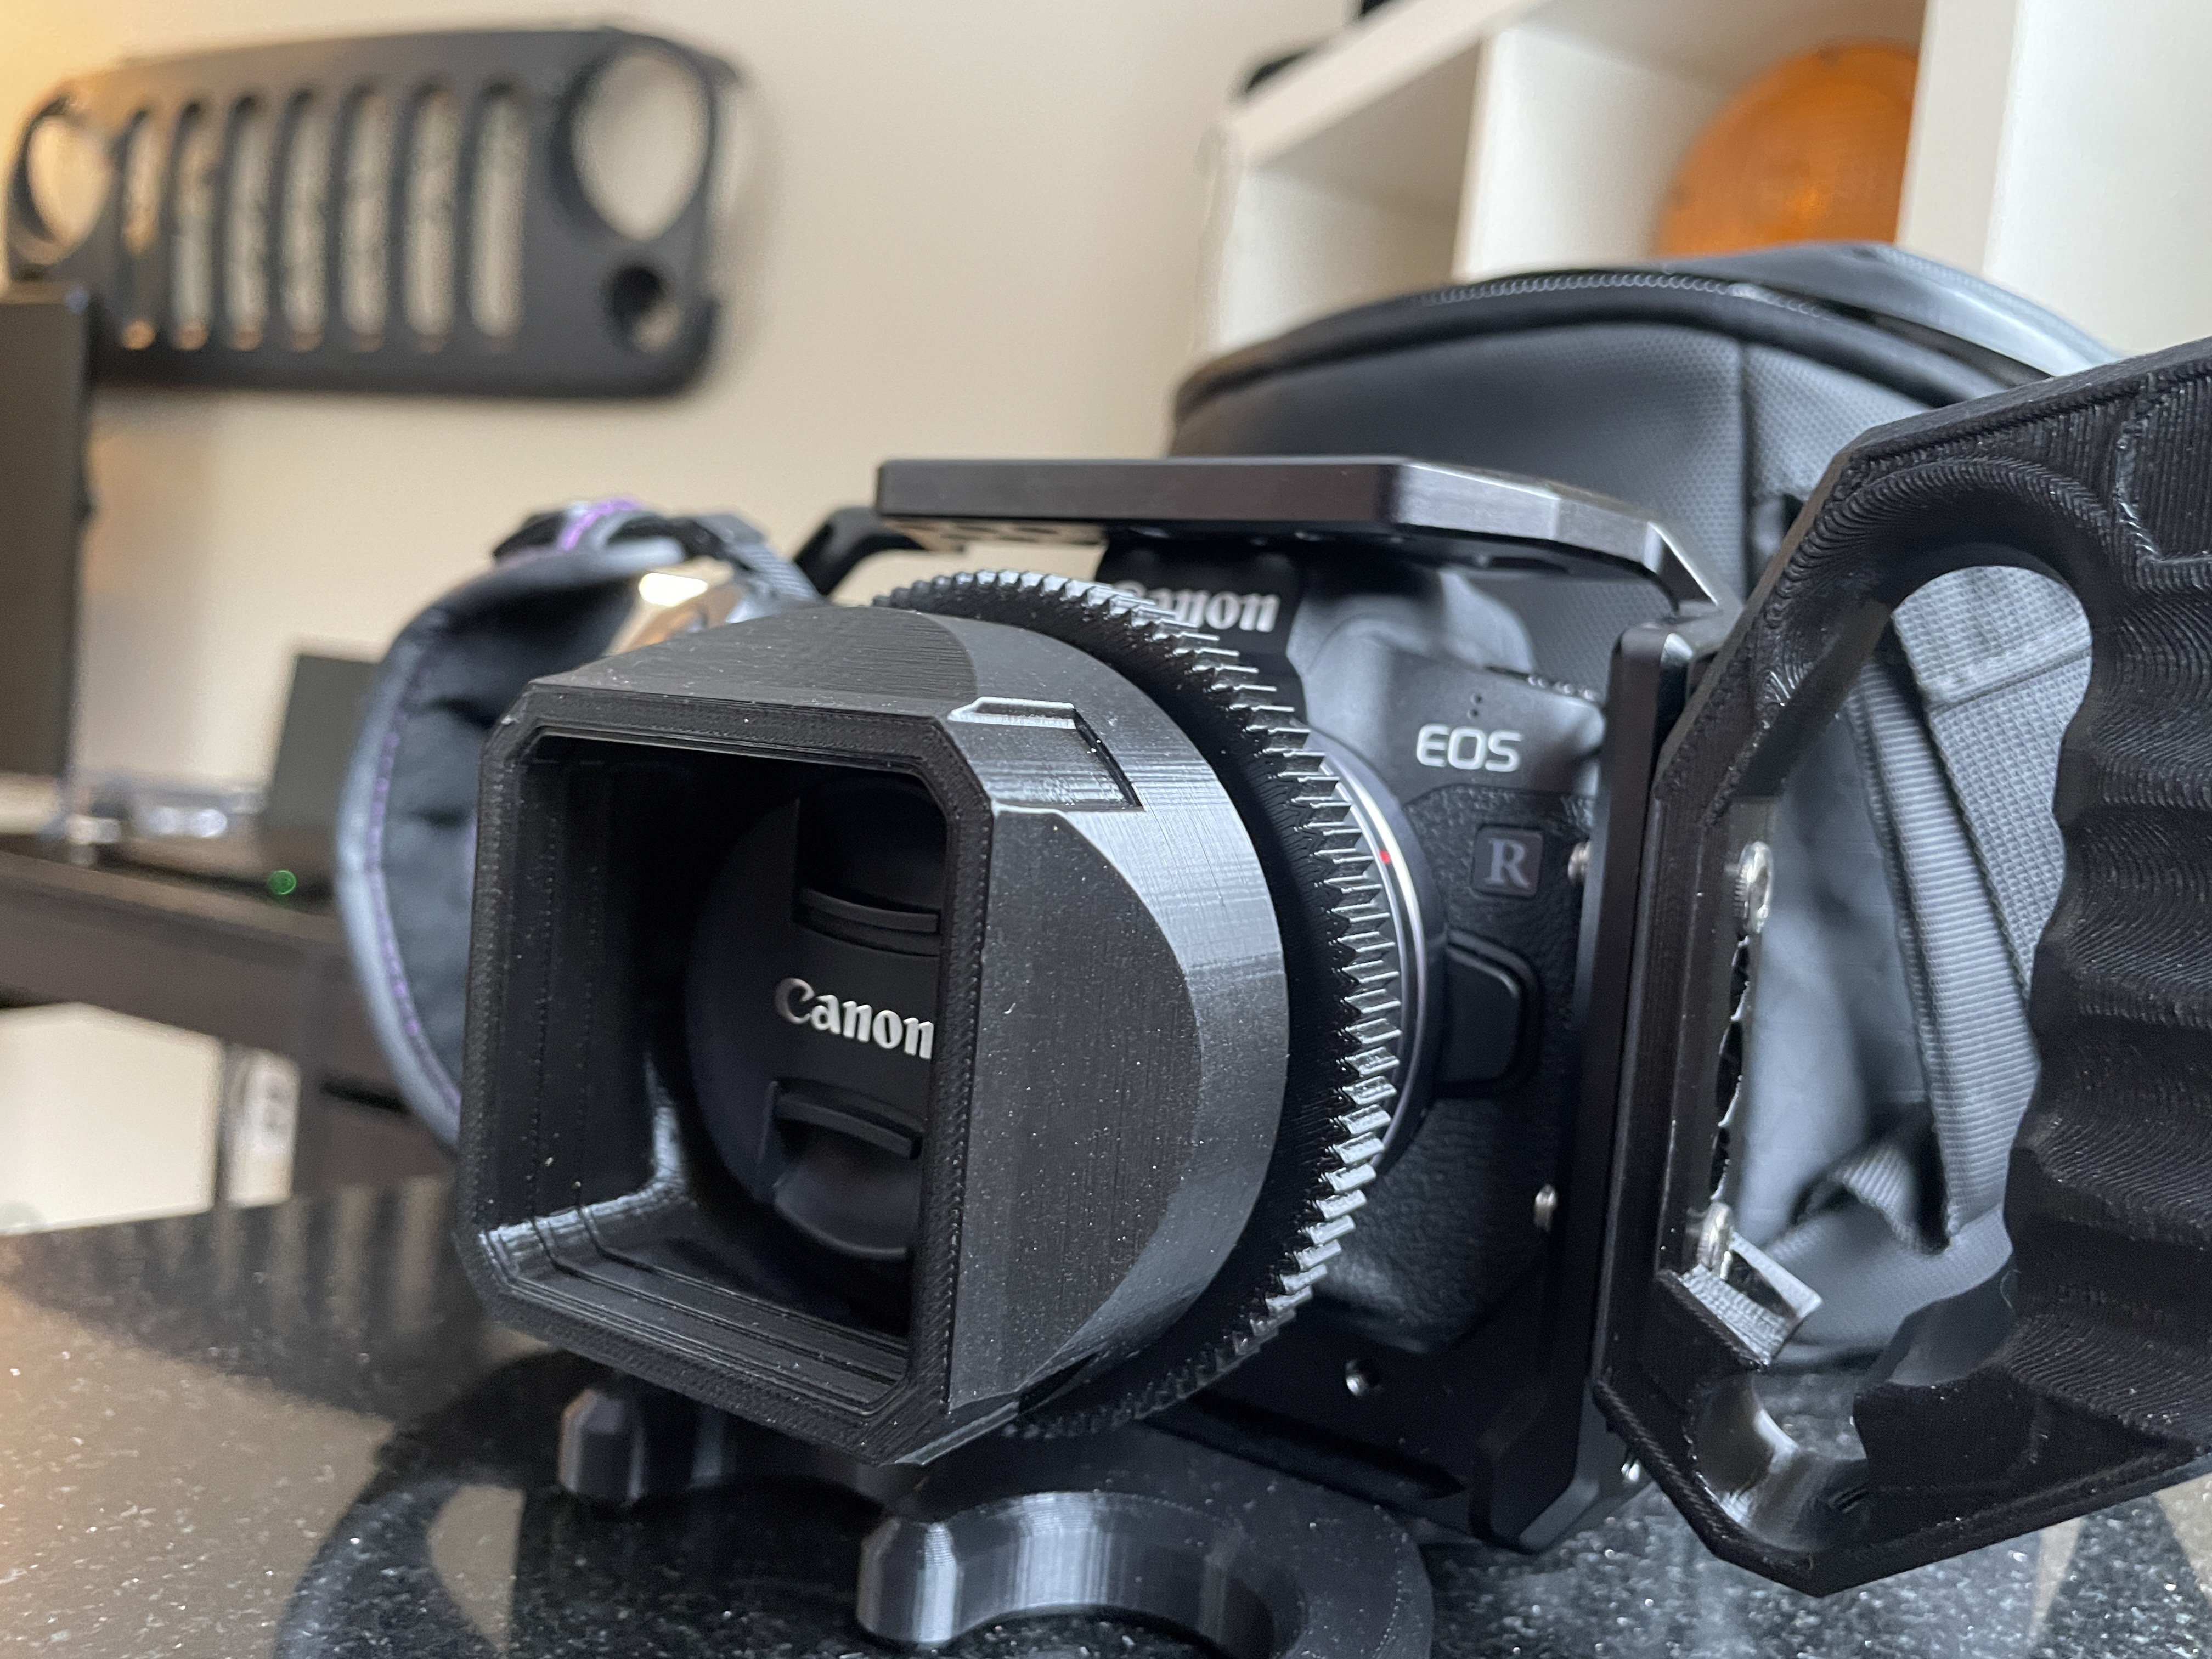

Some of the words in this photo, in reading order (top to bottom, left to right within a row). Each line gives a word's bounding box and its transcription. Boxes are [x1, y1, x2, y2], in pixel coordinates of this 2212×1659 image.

[1415, 723, 1523, 772] EOS
[1484, 838, 1531, 889] R
[774, 977, 934, 1059] Canon
